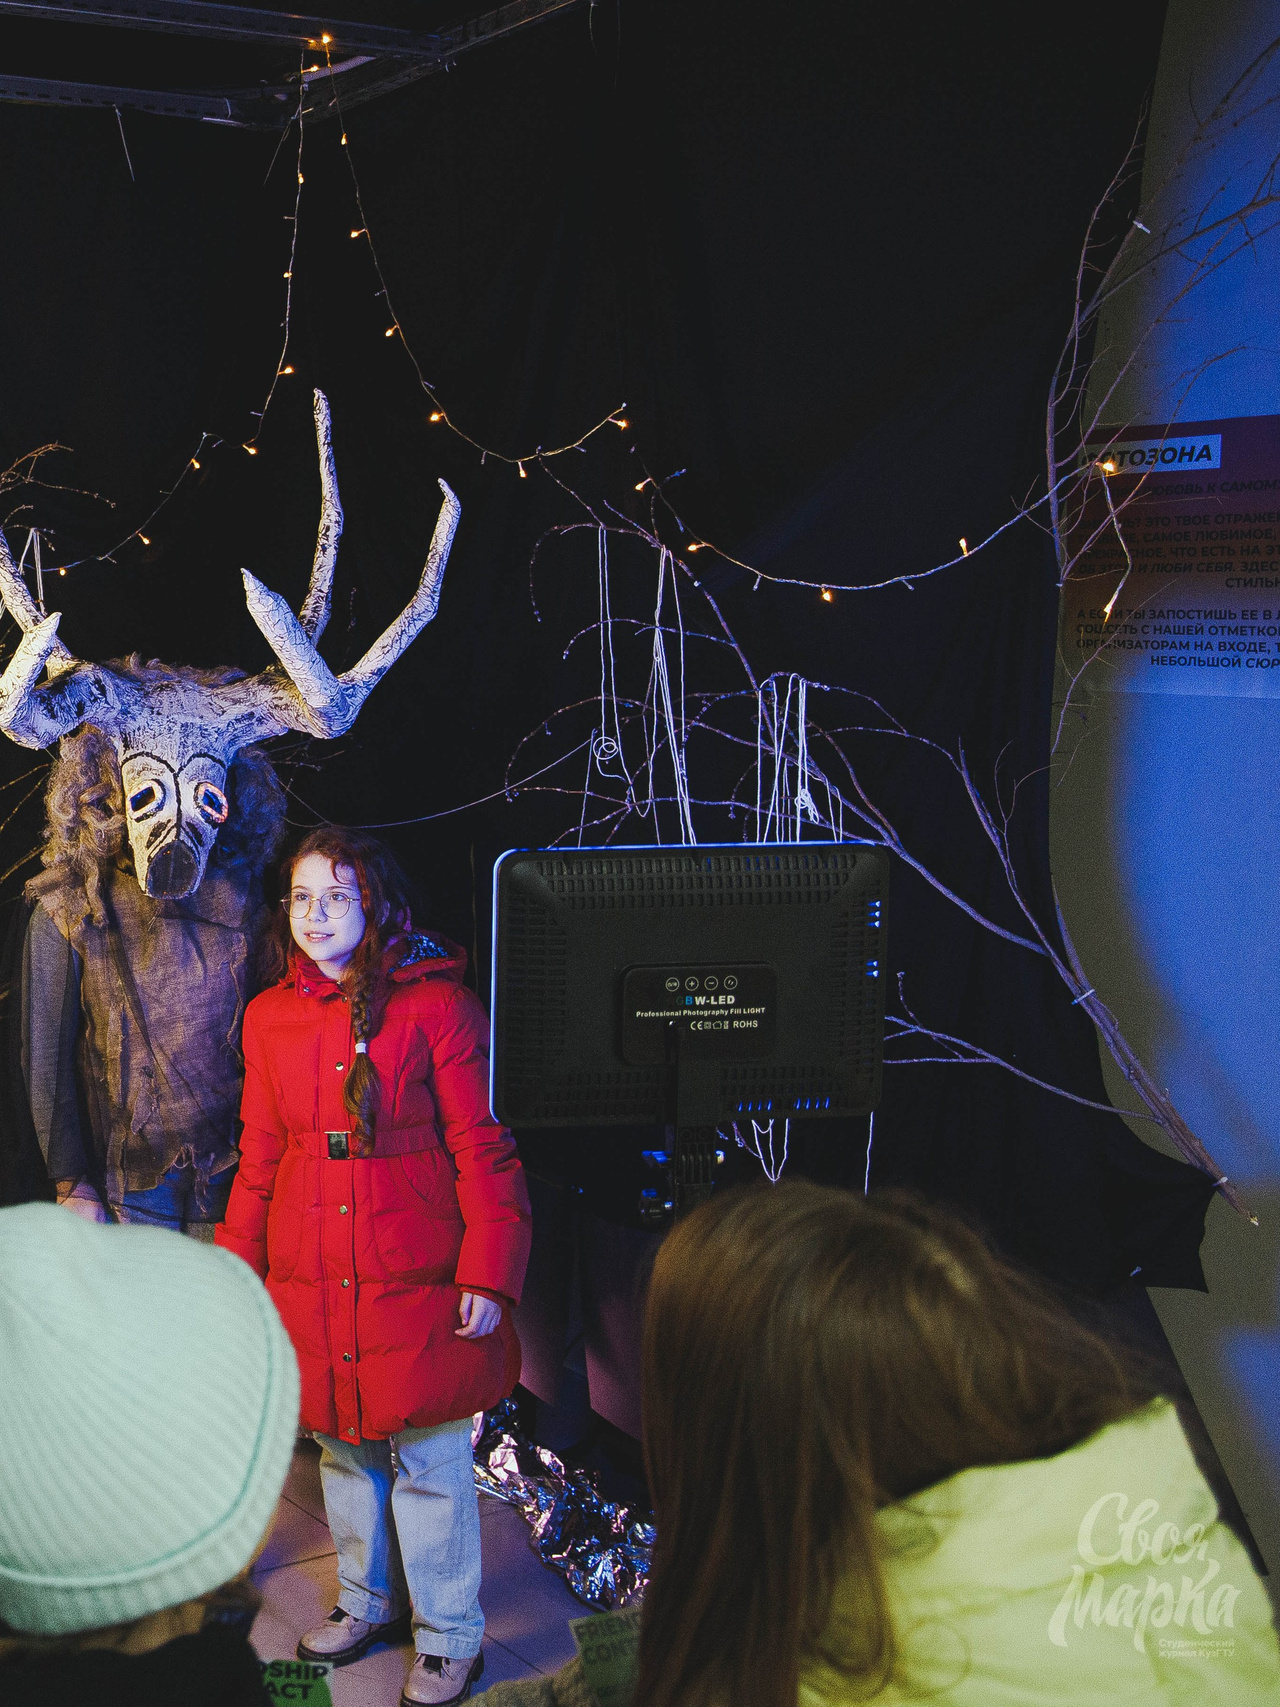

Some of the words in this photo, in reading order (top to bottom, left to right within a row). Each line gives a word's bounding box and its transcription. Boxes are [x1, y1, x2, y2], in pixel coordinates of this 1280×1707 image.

[1206, 481, 1218, 494] К
[1145, 516, 1170, 527] ЭТО
[1174, 514, 1212, 526] ТВОЕ
[1143, 531, 1191, 543] САМОЕ
[1194, 528, 1277, 542] ЛЮБИМОЕ,
[1170, 546, 1198, 558] ЧТО
[1201, 545, 1236, 557] ЕСТЬ
[1240, 544, 1261, 556] НА
[1138, 563, 1148, 575] И
[1150, 562, 1193, 574] ЛЮБИ
[1196, 561, 1236, 573] СЕБЯ.
[1077, 608, 1086, 619] А
[1089, 608, 1123, 620] ЕСИ
[1149, 608, 1237, 620] ЗАПОСТИШЬ
[1241, 609, 1259, 620] ЕЕ
[1262, 609, 1273, 620] В
[1141, 624, 1150, 635] С
[1153, 623, 1204, 635] НАШЕЙ
[1194, 640, 1213, 651] НА
[1217, 641, 1272, 655] ВХОДЕ,
[1150, 654, 1242, 669] НЕБОЛЬШОЙ
[636, 1009, 682, 1018] Professional
[683, 1008, 729, 1018] Photography
[730, 1007, 742, 1015] Fill
[690, 1020, 703, 1031] CE
[733, 1020, 759, 1029] ROHS
